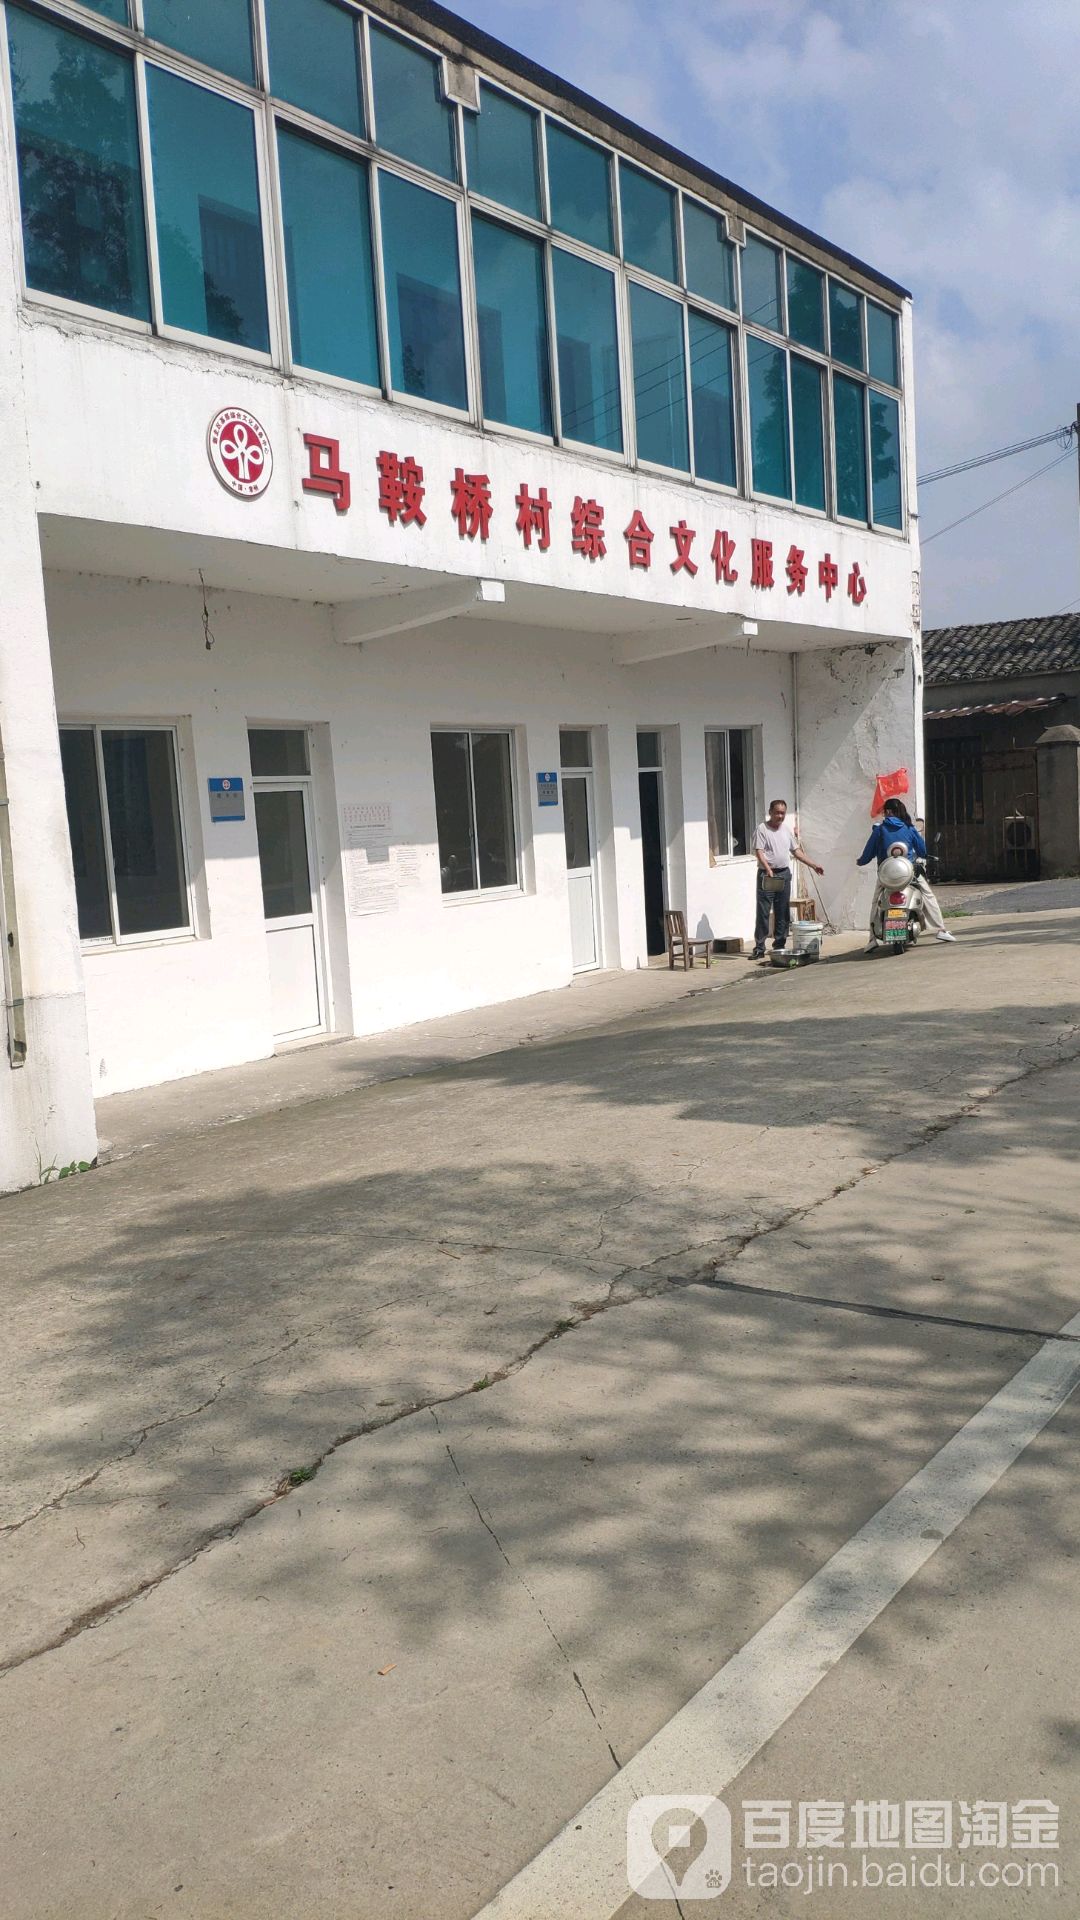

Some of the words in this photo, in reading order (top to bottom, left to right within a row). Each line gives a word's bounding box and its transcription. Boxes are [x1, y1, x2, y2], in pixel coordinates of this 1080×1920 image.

[302, 432, 868, 605] 马鞍桥村综合文化服务中心
